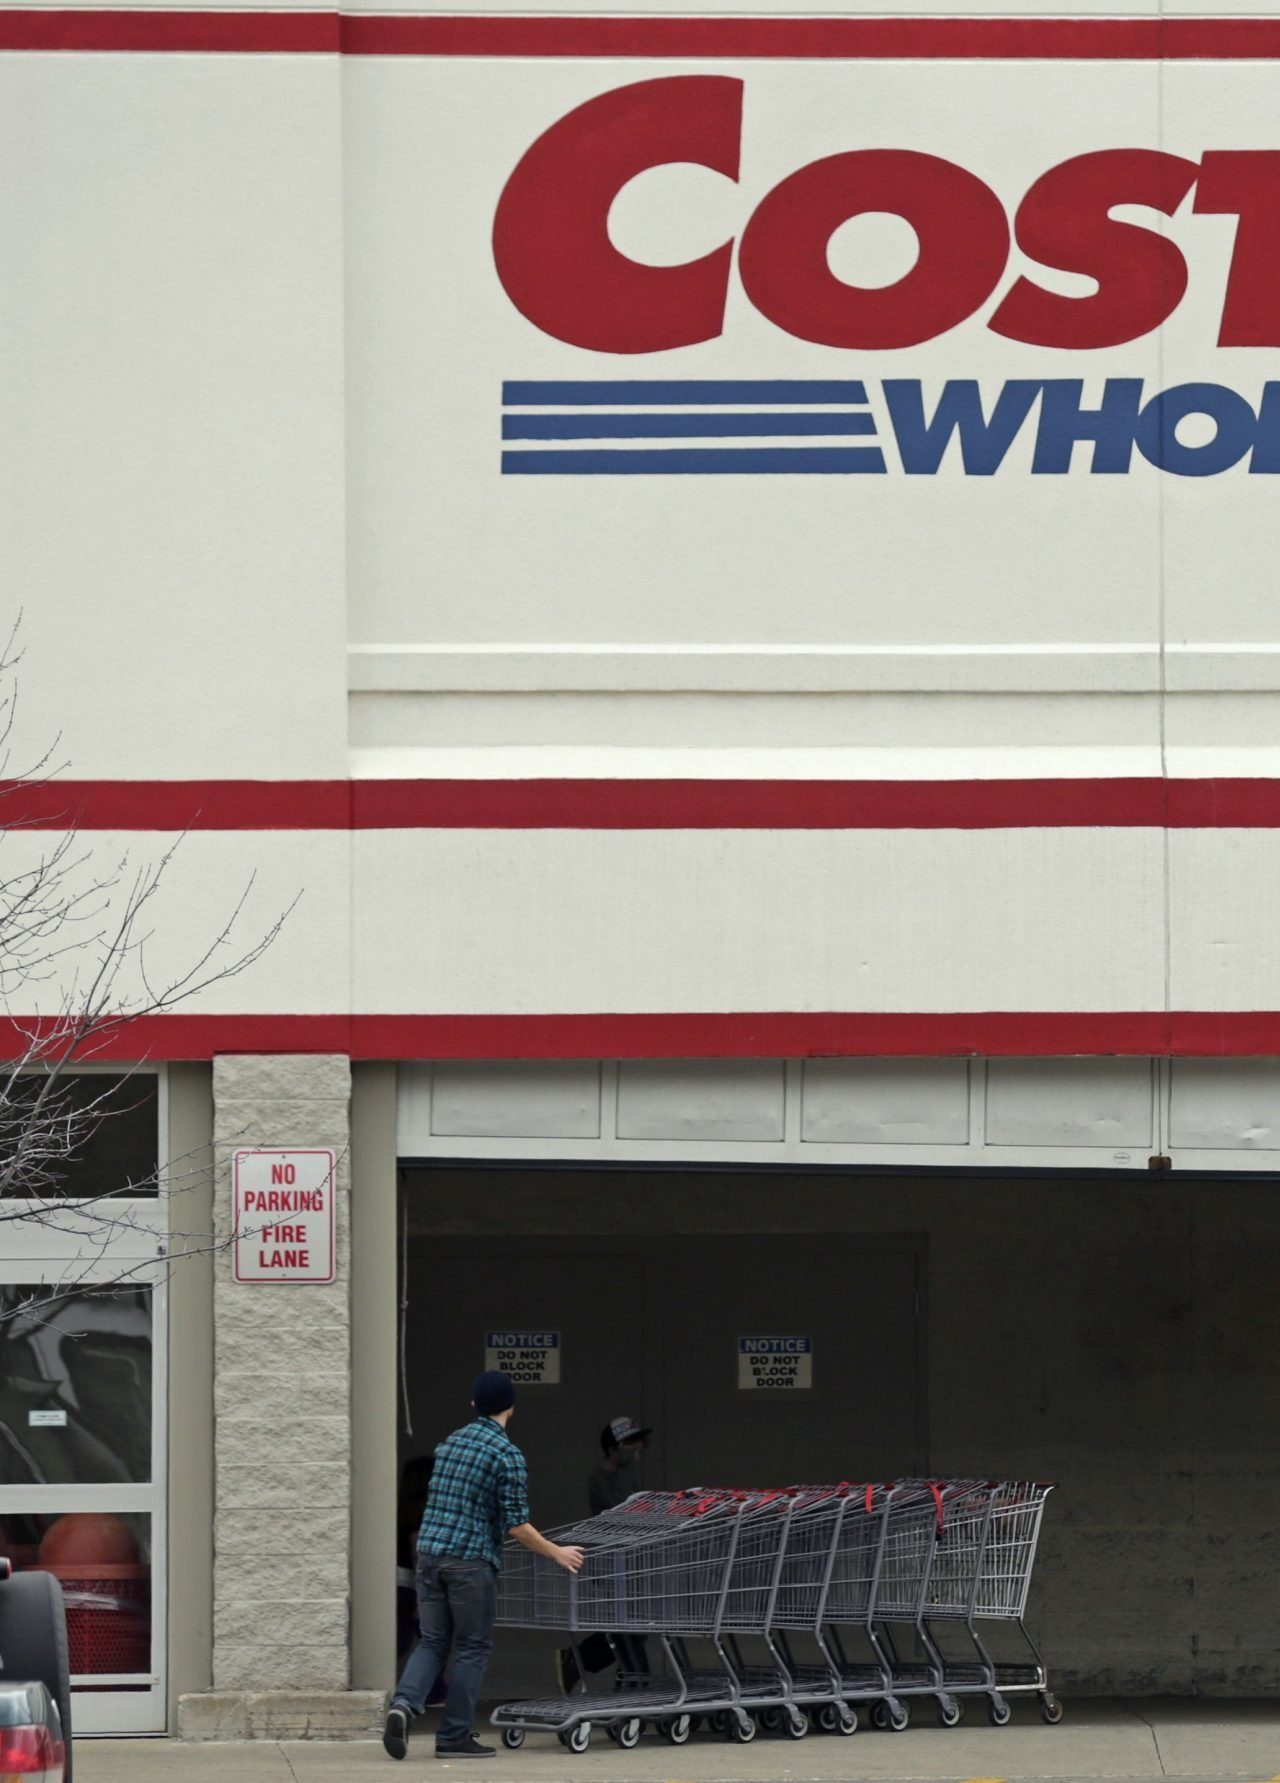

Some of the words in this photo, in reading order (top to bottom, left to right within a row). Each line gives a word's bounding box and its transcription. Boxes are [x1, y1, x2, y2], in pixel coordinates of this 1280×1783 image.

[271, 1163, 295, 1185] NO
[243, 1190, 324, 1212] PARKING
[261, 1224, 307, 1243] FIRE
[258, 1249, 310, 1268] LANE
[492, 1334, 553, 1346] NOTICE
[745, 1340, 806, 1352] NOTICE
[497, 1351, 516, 1360] DO
[520, 1351, 548, 1360] NOT
[750, 1356, 769, 1365] DO
[773, 1356, 800, 1365] NOT
[500, 1361, 545, 1371] BLOCK
[753, 1367, 798, 1376] BLOCK
[757, 1377, 795, 1387] DOOR
